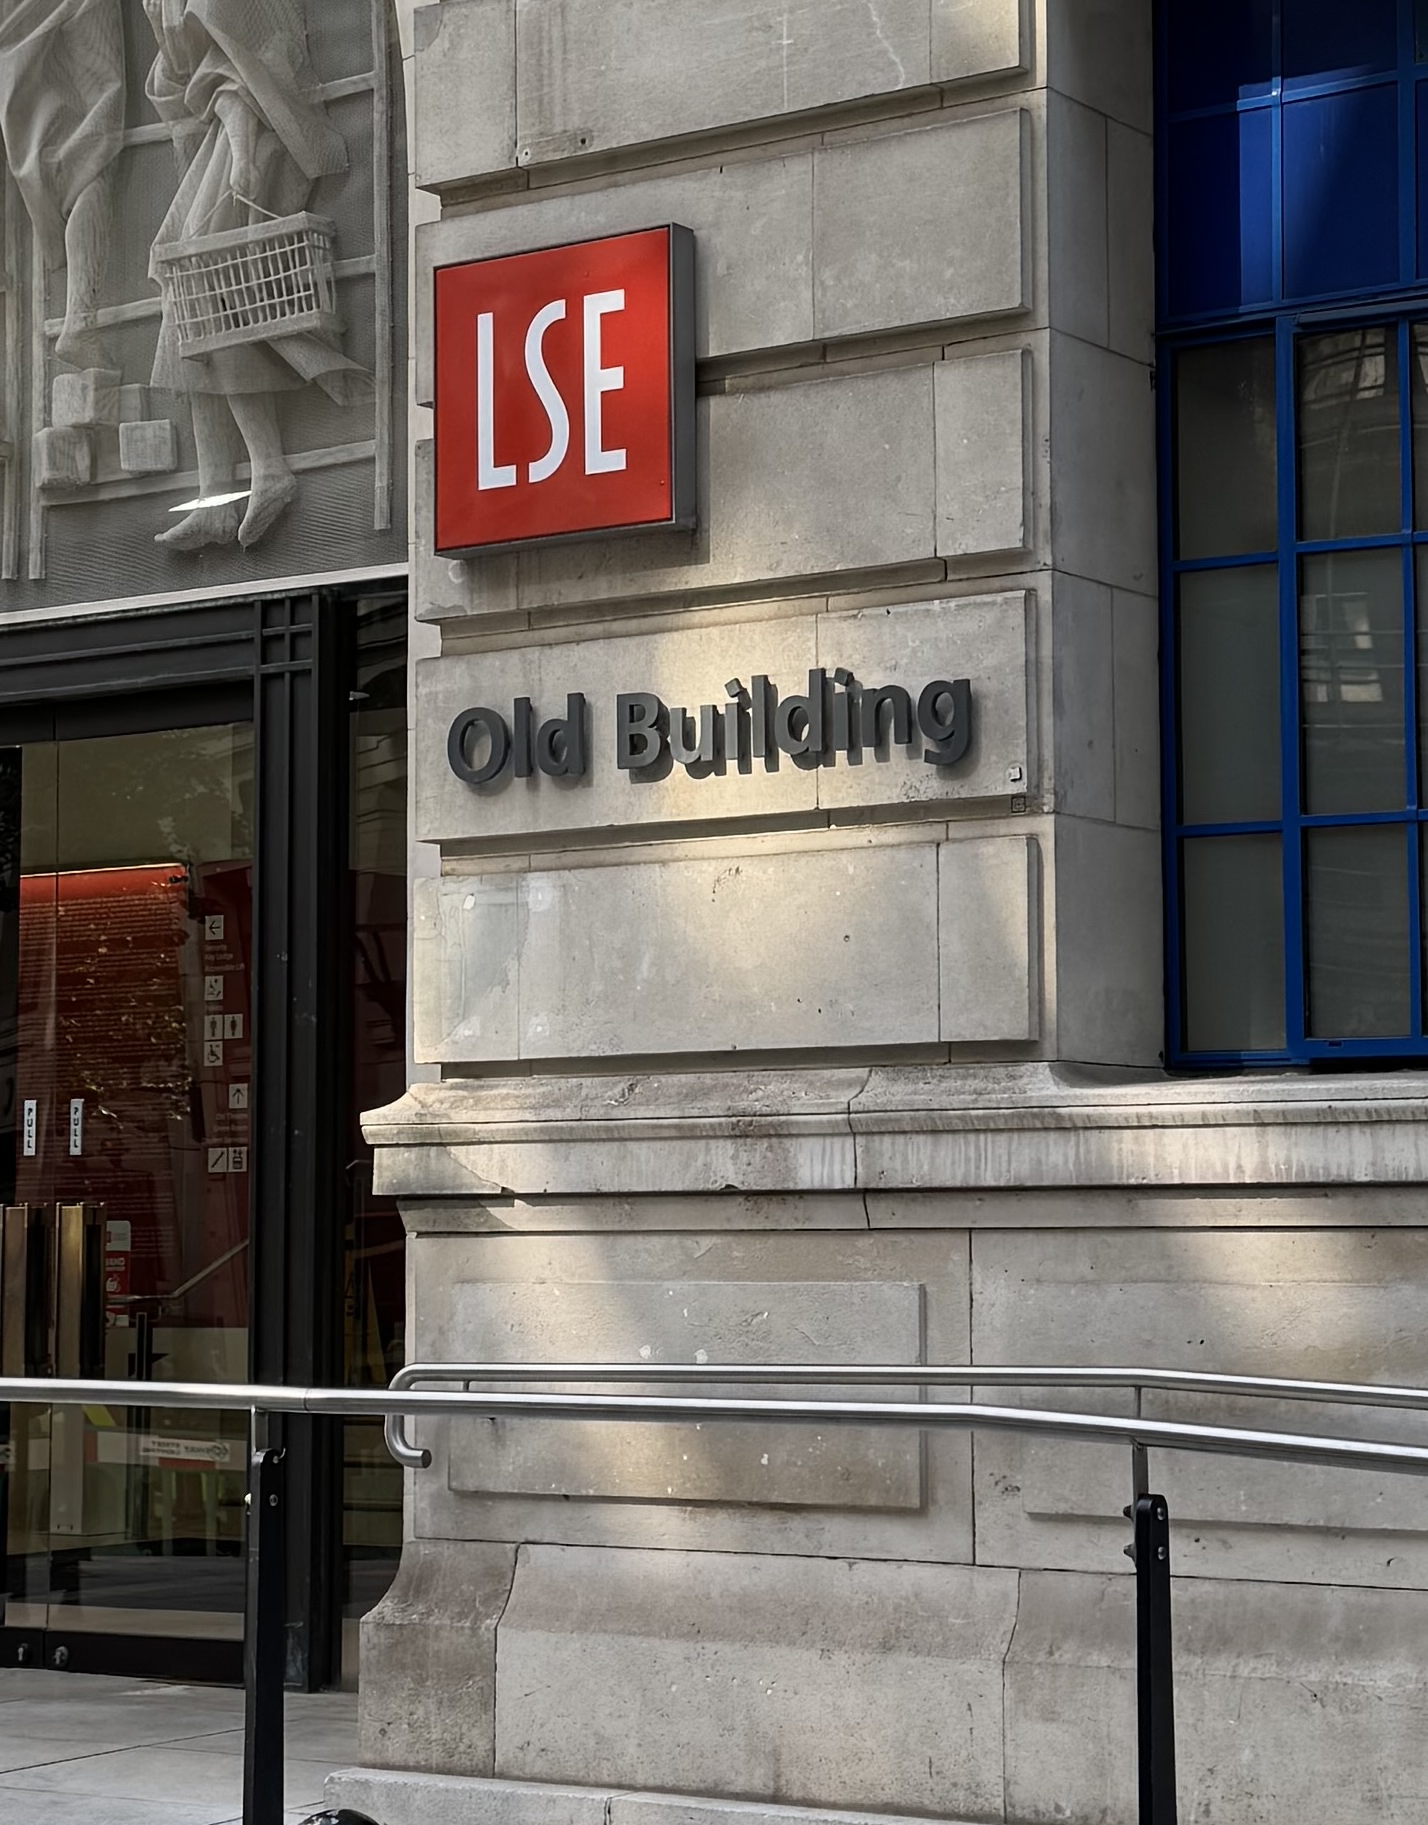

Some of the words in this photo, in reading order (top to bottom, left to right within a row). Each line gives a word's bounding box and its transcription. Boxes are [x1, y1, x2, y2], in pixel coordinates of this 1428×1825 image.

[477, 288, 628, 491] LSE
[446, 691, 586, 784] Old
[615, 667, 973, 770] Building
[26, 1107, 34, 1149] PULL
